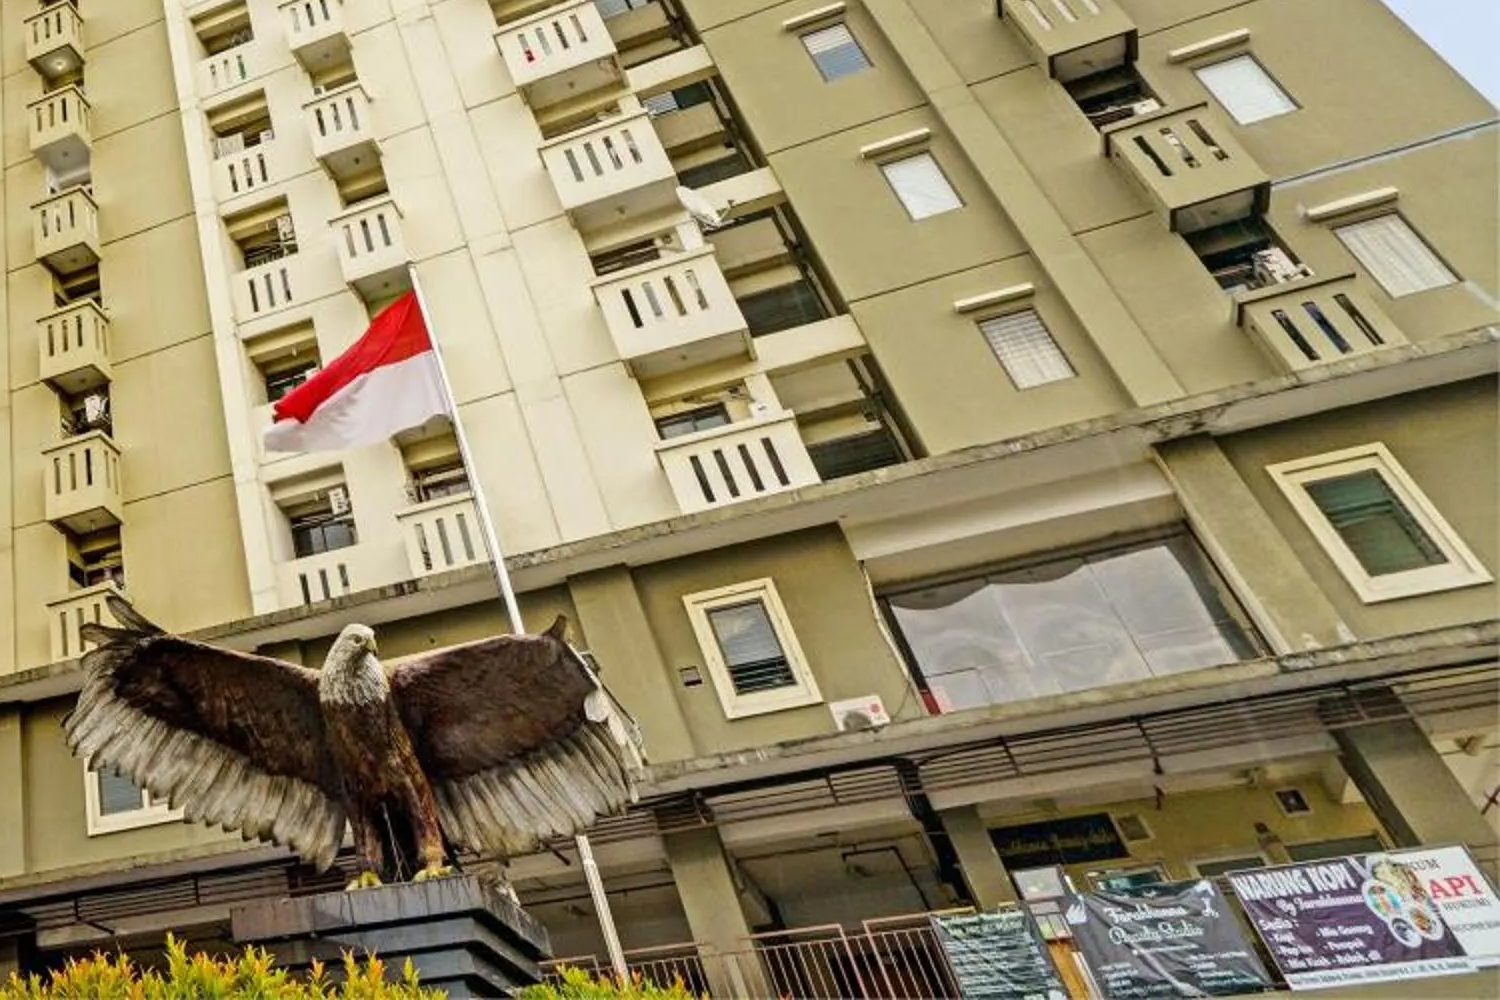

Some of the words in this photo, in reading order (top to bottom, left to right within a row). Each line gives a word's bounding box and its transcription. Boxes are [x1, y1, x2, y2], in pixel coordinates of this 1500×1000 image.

[1231, 869, 1313, 901] WARUNG
[1306, 863, 1357, 891] KOPI
[1429, 874, 1483, 898] API
